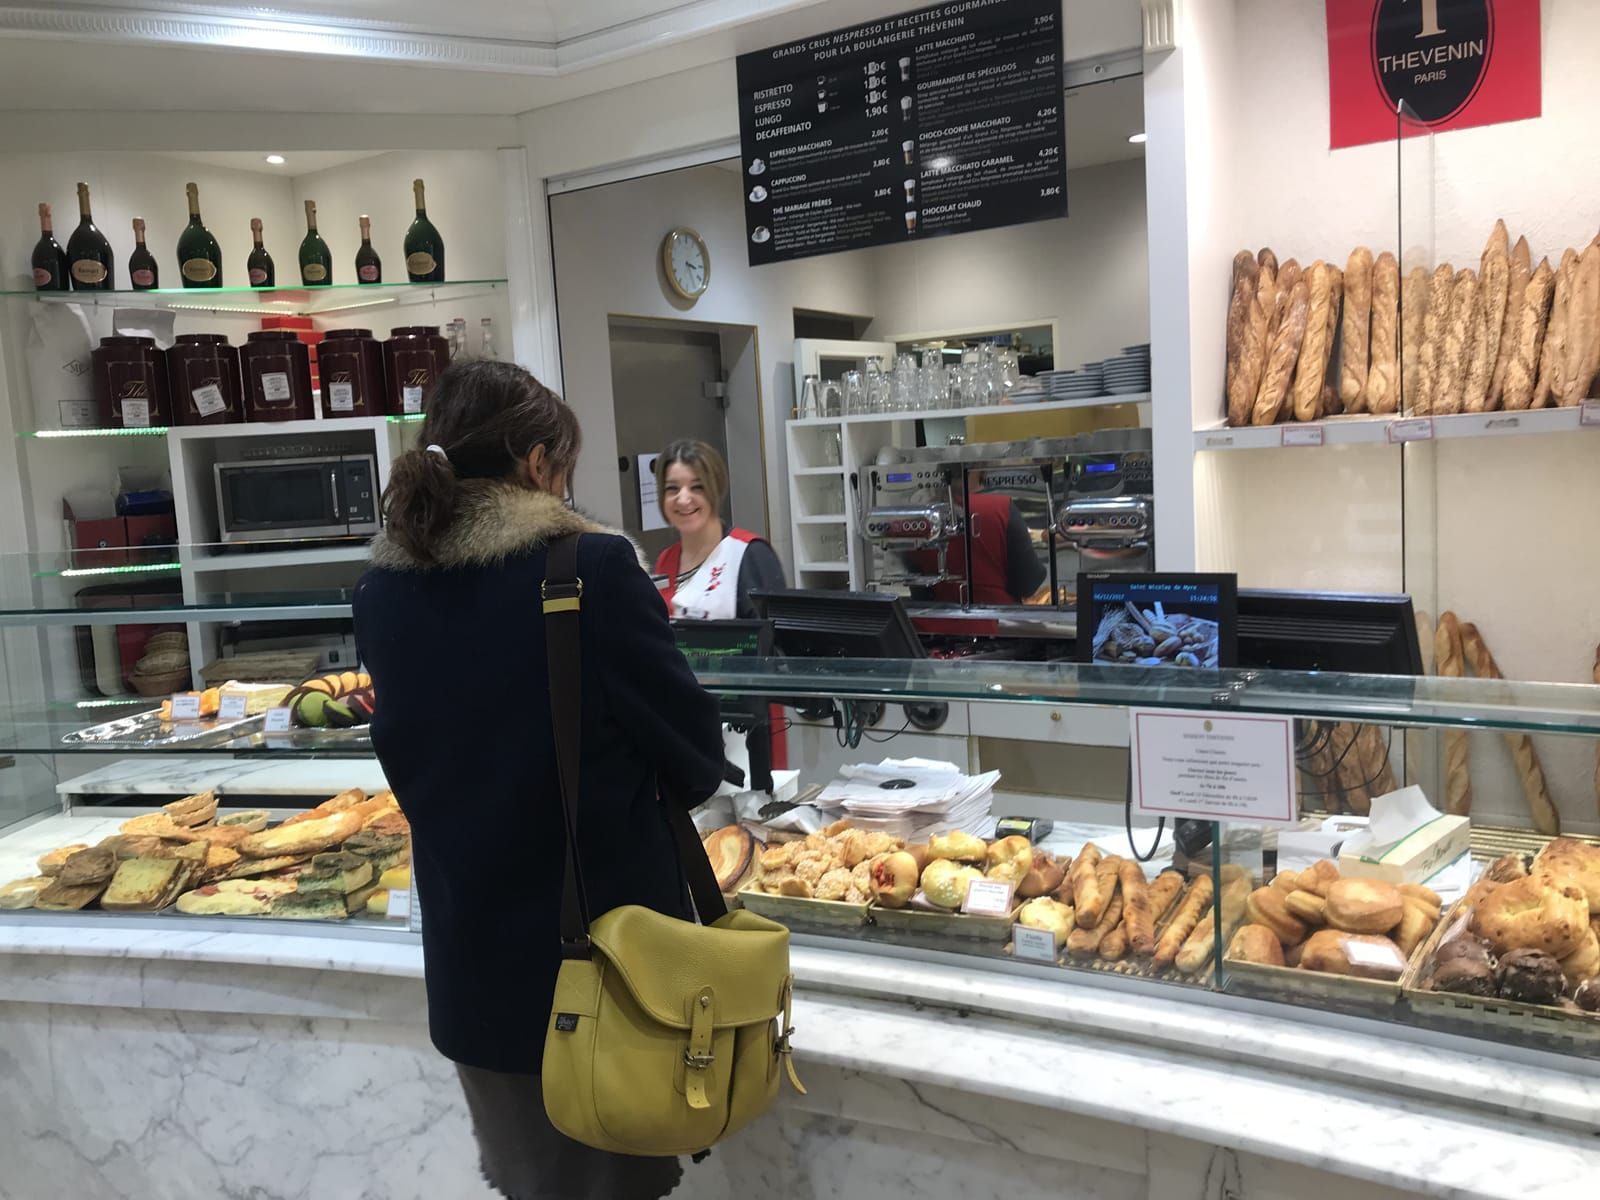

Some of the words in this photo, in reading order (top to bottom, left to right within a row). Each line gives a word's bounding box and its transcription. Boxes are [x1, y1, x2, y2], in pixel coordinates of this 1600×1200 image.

[772, 44, 806, 59] GRANDS
[809, 37, 830, 50] CRUS
[833, 25, 882, 44] NESPRESSO
[885, 21, 895, 31] ET
[898, 9, 941, 28] RECETTES
[814, 48, 837, 61] POUR
[840, 45, 851, 55] LA
[854, 29, 915, 51] BOULANGERIE
[918, 16, 964, 35] THÉVENIN
[915, 42, 933, 53] LATTE
[935, 33, 975, 48] MACCHIATO
[1379, 39, 1484, 73] THEVENIN
[917, 73, 965, 91] GOURMANDISE
[967, 71, 976, 80] DE
[977, 62, 1017, 78] SPÉCULOOS
[1414, 69, 1447, 84] PARIS
[754, 83, 793, 100] RISTRETTO
[754, 98, 791, 114] ESPRESSO
[755, 114, 782, 127] LUNGO
[919, 124, 968, 141] CHOCO-COOKIE
[970, 116, 1011, 130] MACCHIATO
[756, 121, 812, 141] DECAFFEINATO
[769, 147, 796, 158] ESPRESSO
[797, 139, 832, 152] MACCHIATO
[920, 167, 939, 178] LATTE
[940, 161, 980, 175] MACCHIATO
[981, 155, 1014, 167] CARAMEL
[771, 174, 806, 187] CAPPUCCINO
[784, 202, 810, 213] MARIAGE
[922, 203, 956, 216] CHOCOLAT
[957, 200, 982, 210] CHAUD
